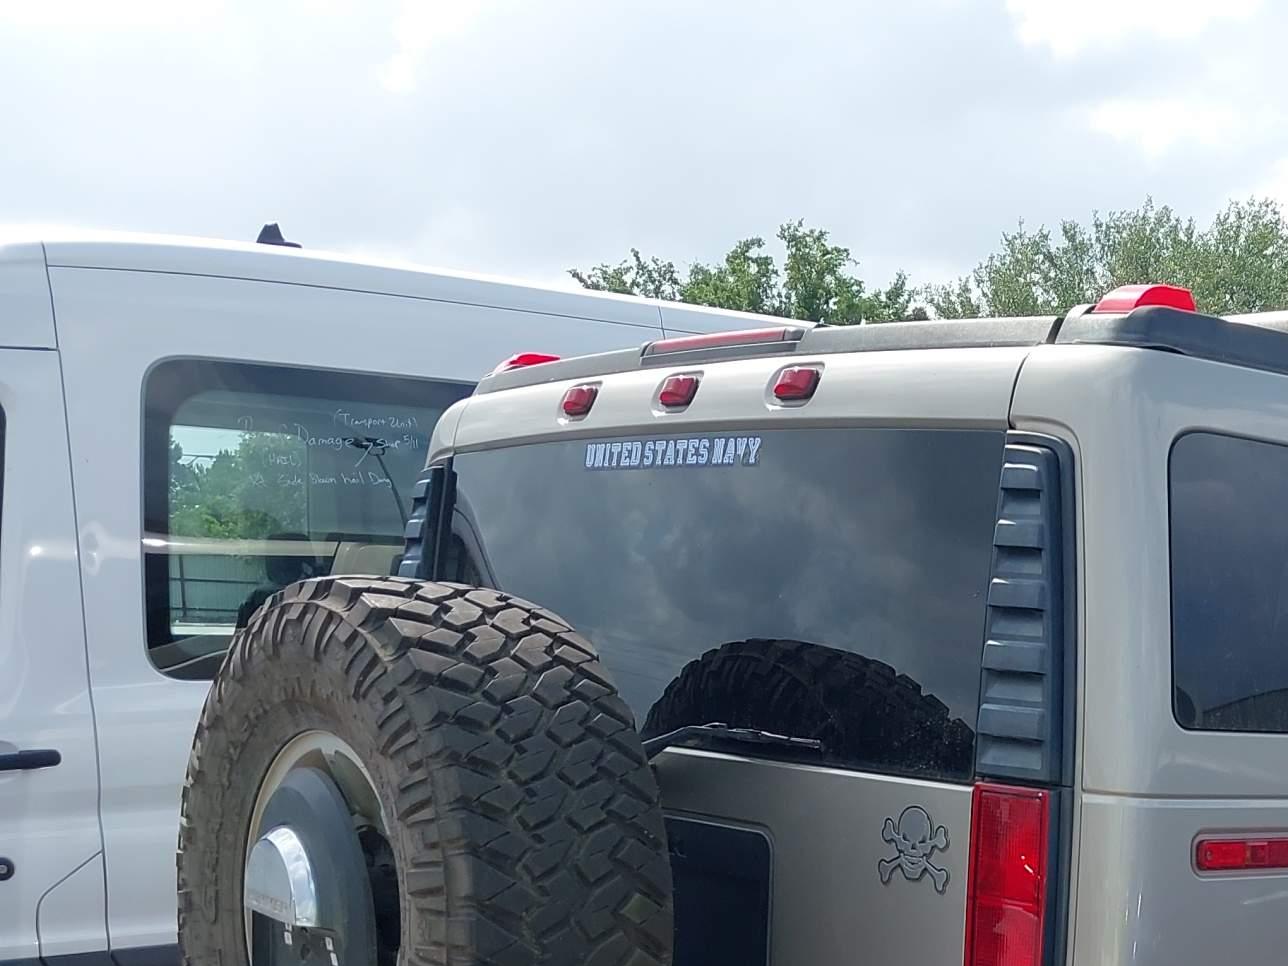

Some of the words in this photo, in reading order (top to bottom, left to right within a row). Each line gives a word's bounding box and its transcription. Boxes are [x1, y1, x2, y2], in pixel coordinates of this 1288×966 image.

[293, 422, 354, 452] Damage
[585, 441, 643, 468] UNITED
[643, 438, 710, 466] STATES
[711, 437, 761, 465] NAVY
